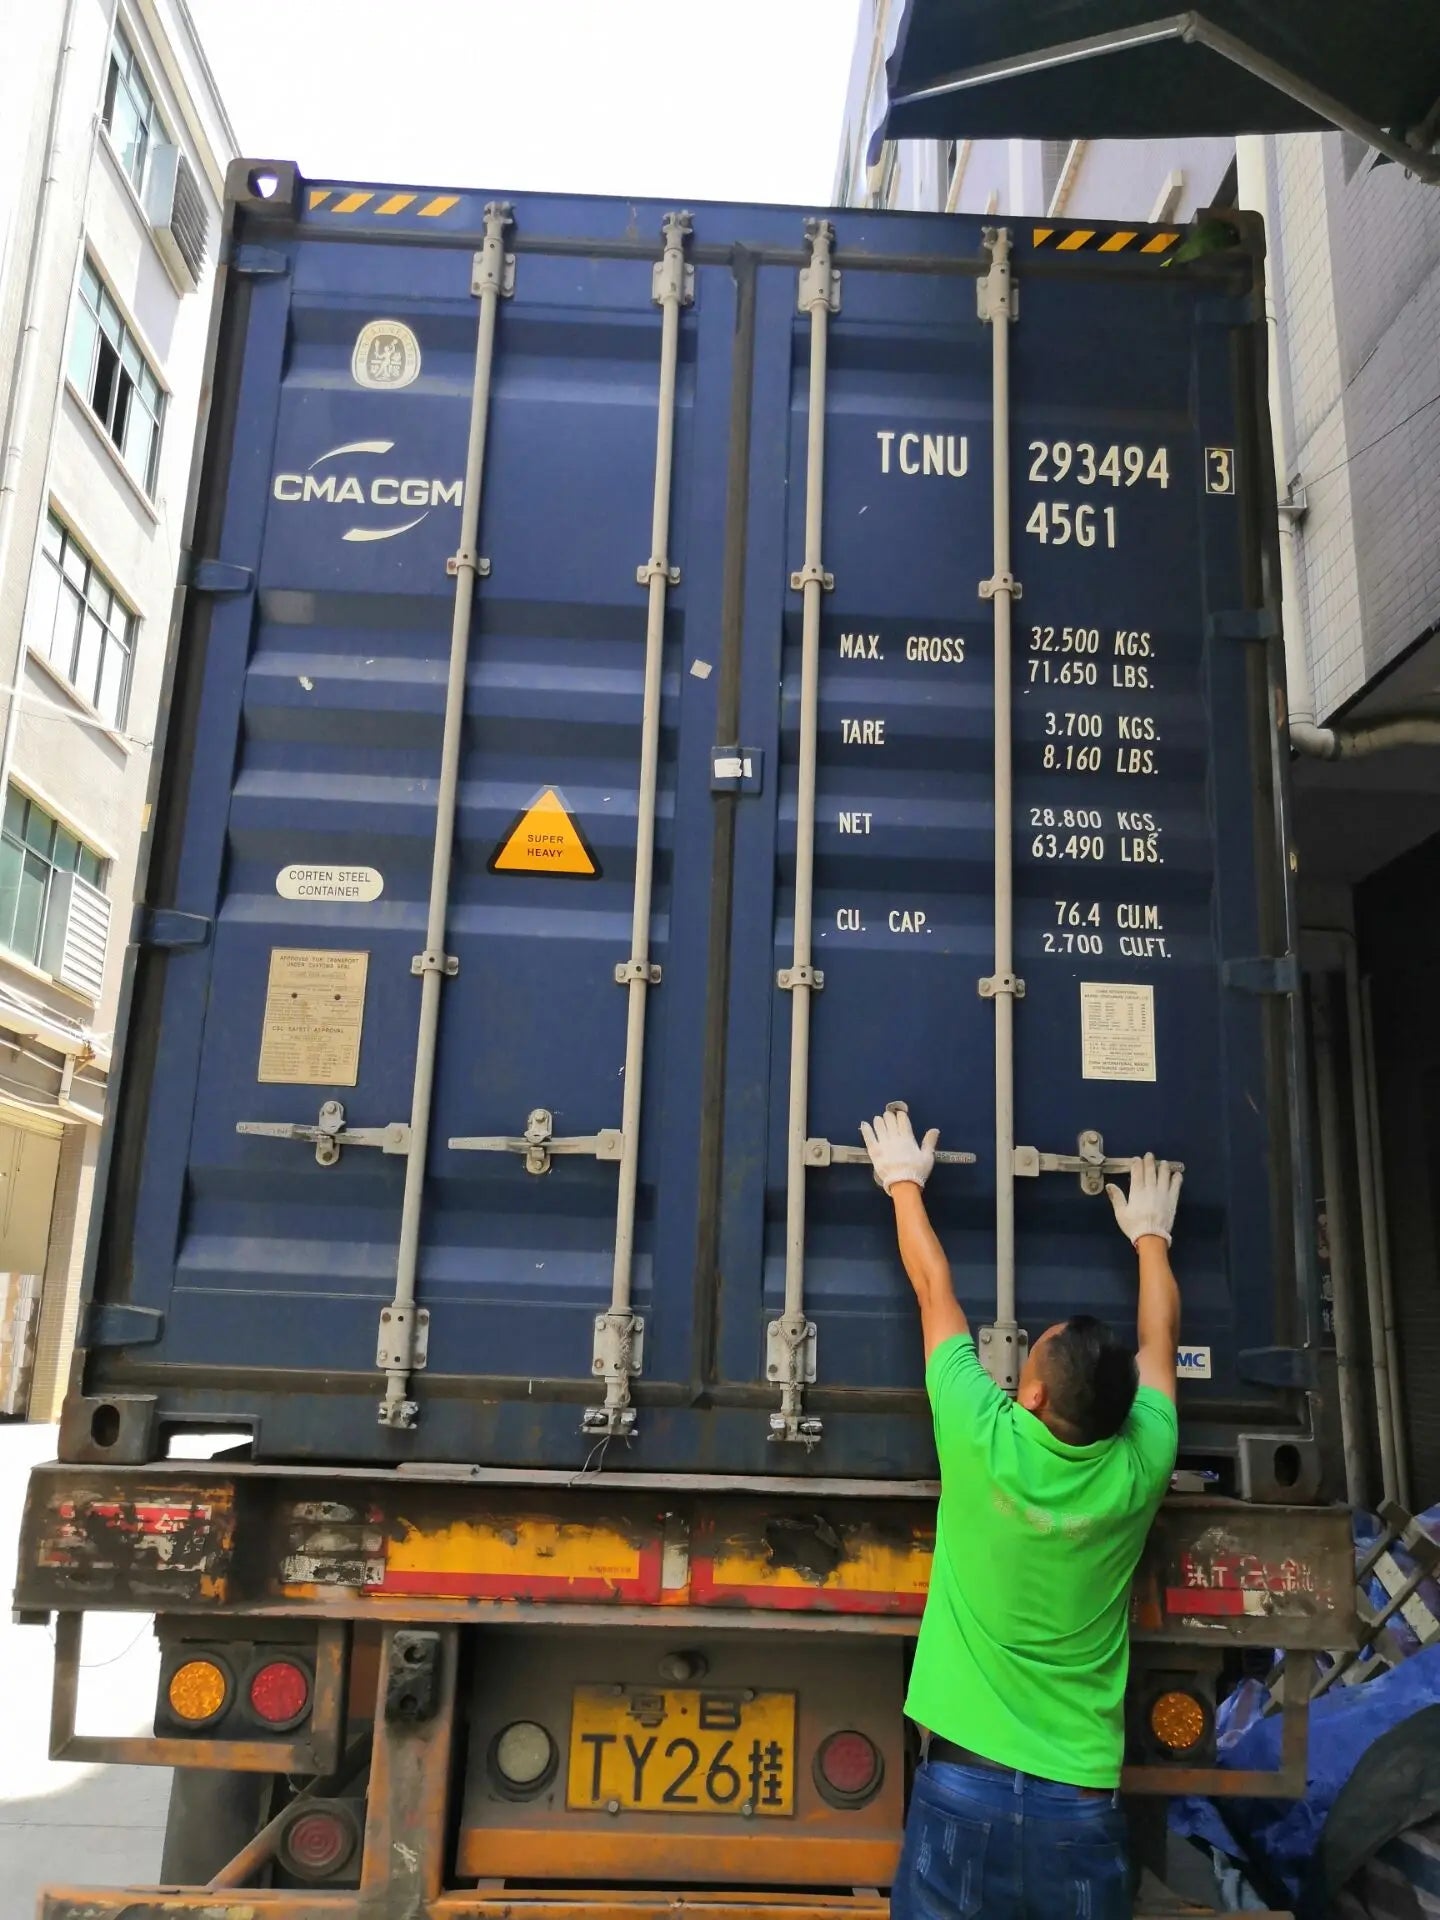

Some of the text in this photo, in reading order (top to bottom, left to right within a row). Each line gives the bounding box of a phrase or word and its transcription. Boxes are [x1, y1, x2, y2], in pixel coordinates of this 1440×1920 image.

[877, 432, 1230, 492] TCNU 293494 3
[273, 474, 463, 507] CMA CGM
[1025, 502, 1115, 548] 45G1
[839, 625, 1155, 663] MAX. GROSS 32,500 KGS.
[1028, 659, 1155, 689] 71,650 LBS.
[841, 711, 1161, 745] TARE 3,700 KGS.
[1043, 744, 1159, 775] 8,160 LBS.
[838, 807, 1162, 834] NET 28,800 KGS.
[527, 834, 564, 844] SUPER
[527, 848, 563, 858] HEAVY
[1031, 834, 1164, 864] 63,490 LBS.
[288, 870, 371, 883] CORTEN STEEL
[297, 885, 360, 897] CONTAINER
[836, 901, 1164, 934] CU. CAP. 76.4 CU.M.
[1042, 933, 1172, 958] 2,700 CU.FT.
[581, 1733, 783, 1809] TY26挂
